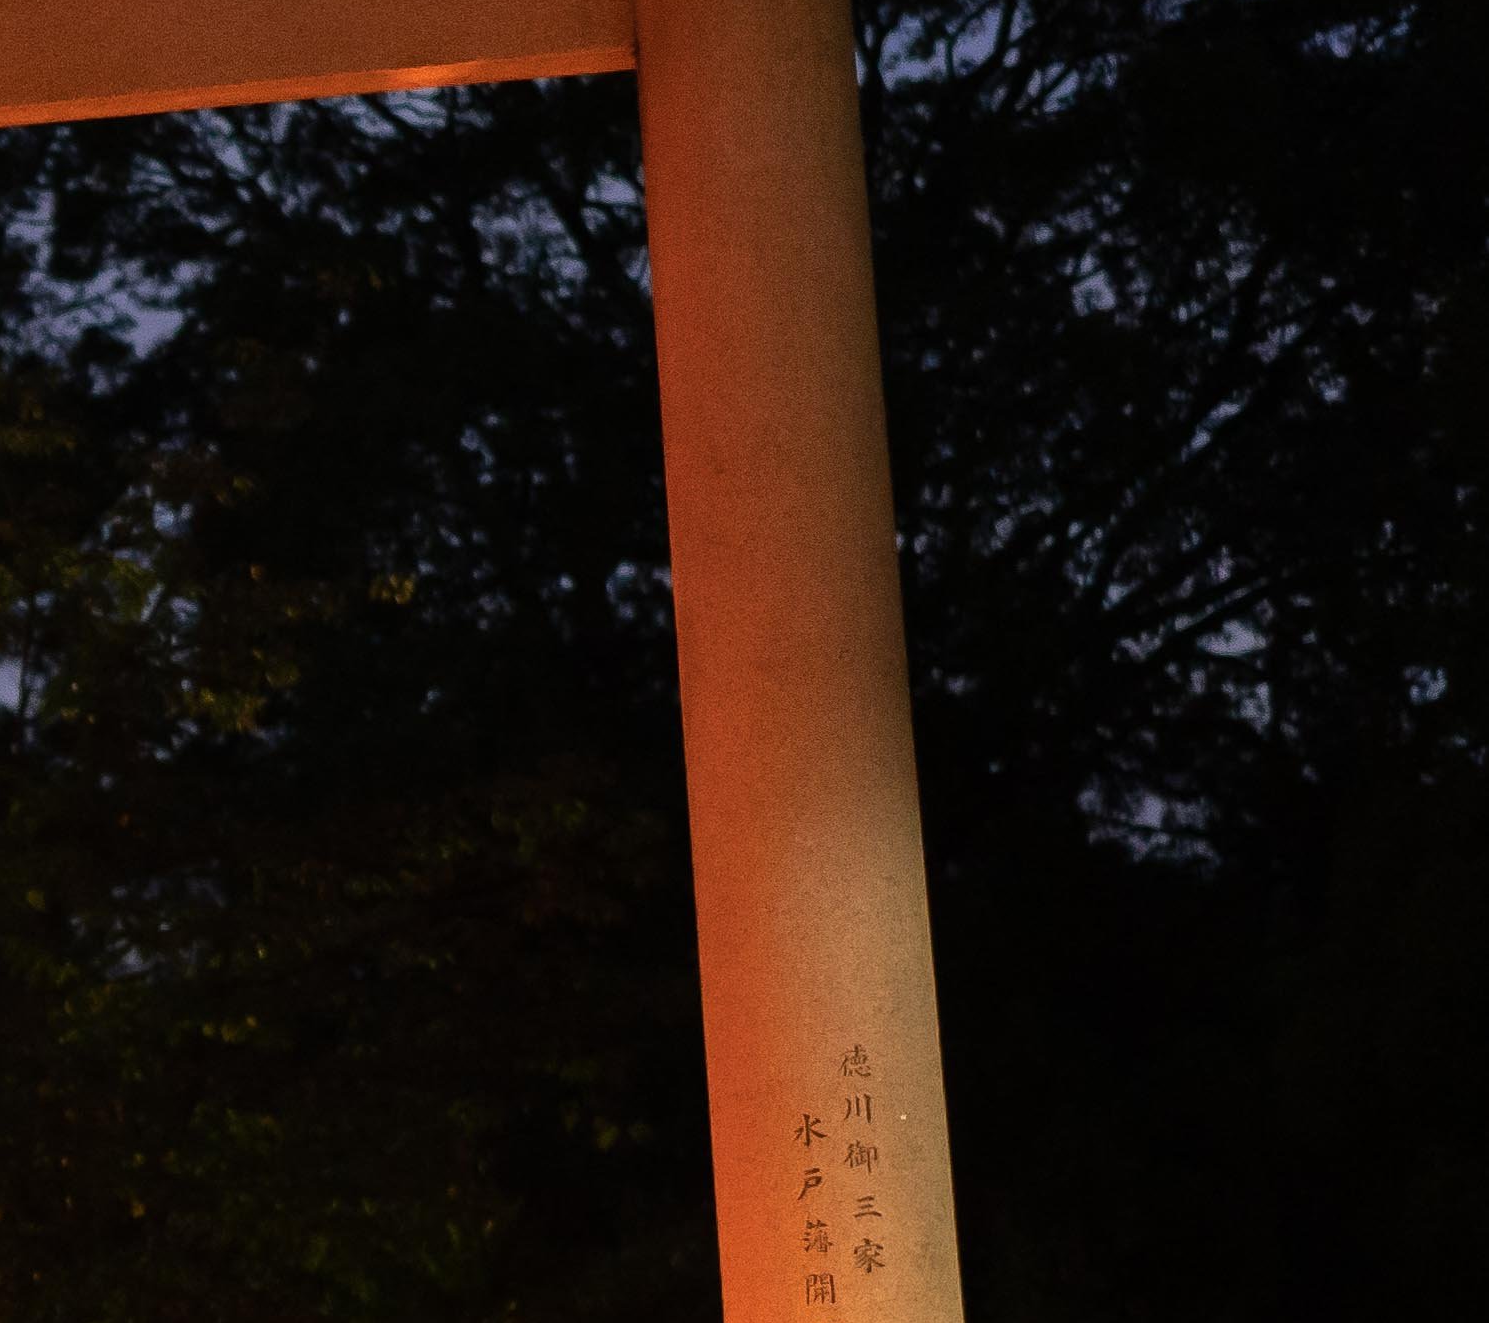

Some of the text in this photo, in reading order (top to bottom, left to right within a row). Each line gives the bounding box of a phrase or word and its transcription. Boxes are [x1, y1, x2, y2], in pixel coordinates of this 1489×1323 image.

[838, 1043, 887, 1275] 徳川御三家
